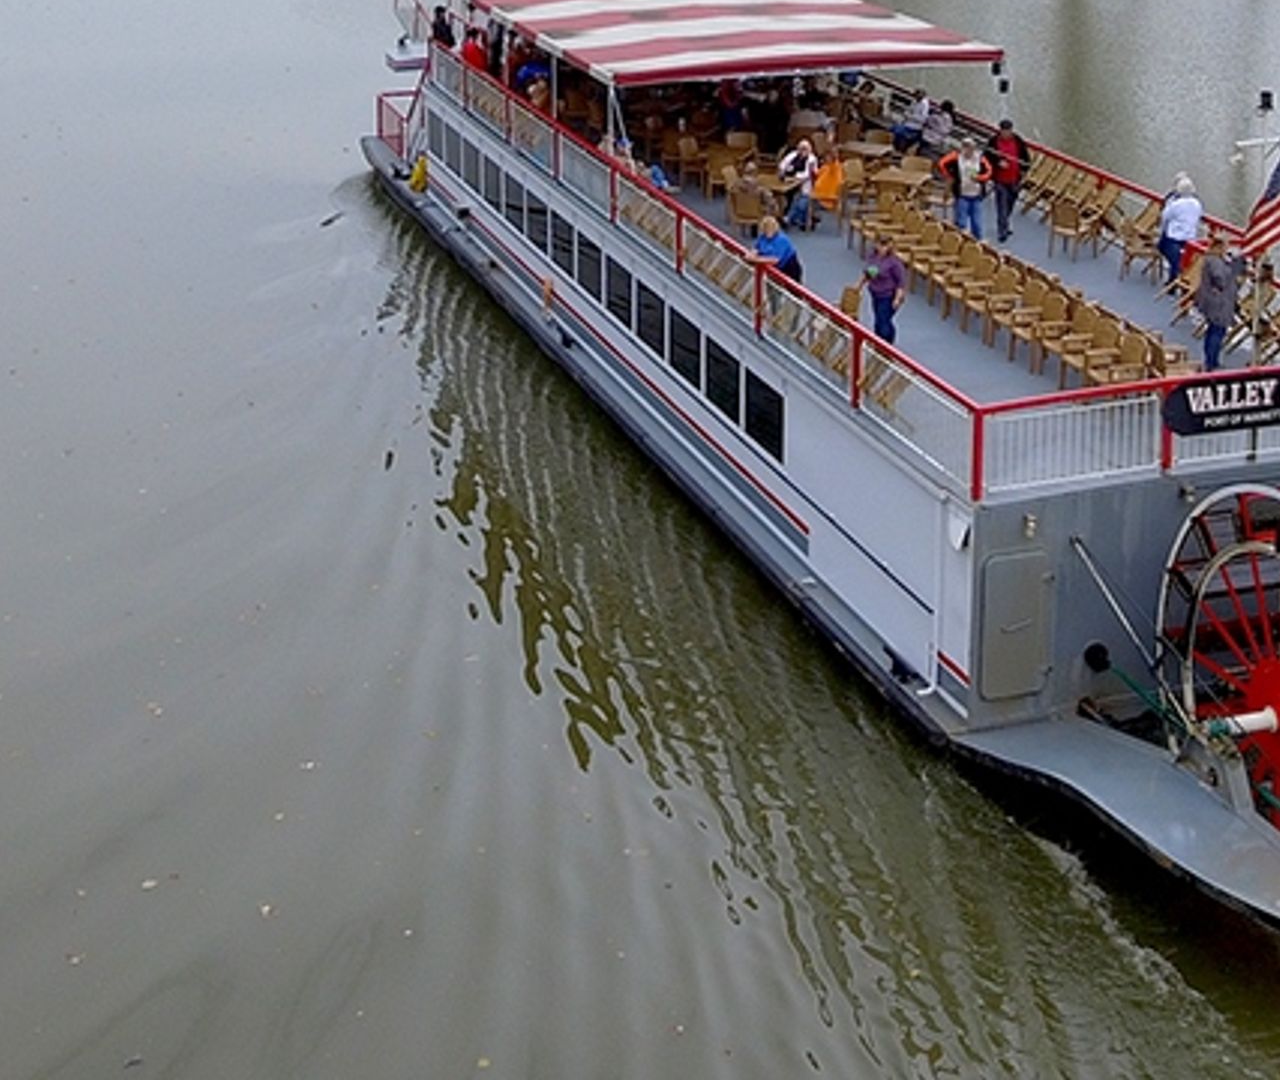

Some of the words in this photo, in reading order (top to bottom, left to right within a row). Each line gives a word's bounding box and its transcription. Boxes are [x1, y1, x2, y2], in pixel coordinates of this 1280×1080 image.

[1186, 378, 1278, 413] VALLEY
[1204, 414, 1229, 428] PORT
[1230, 413, 1241, 425] OF
